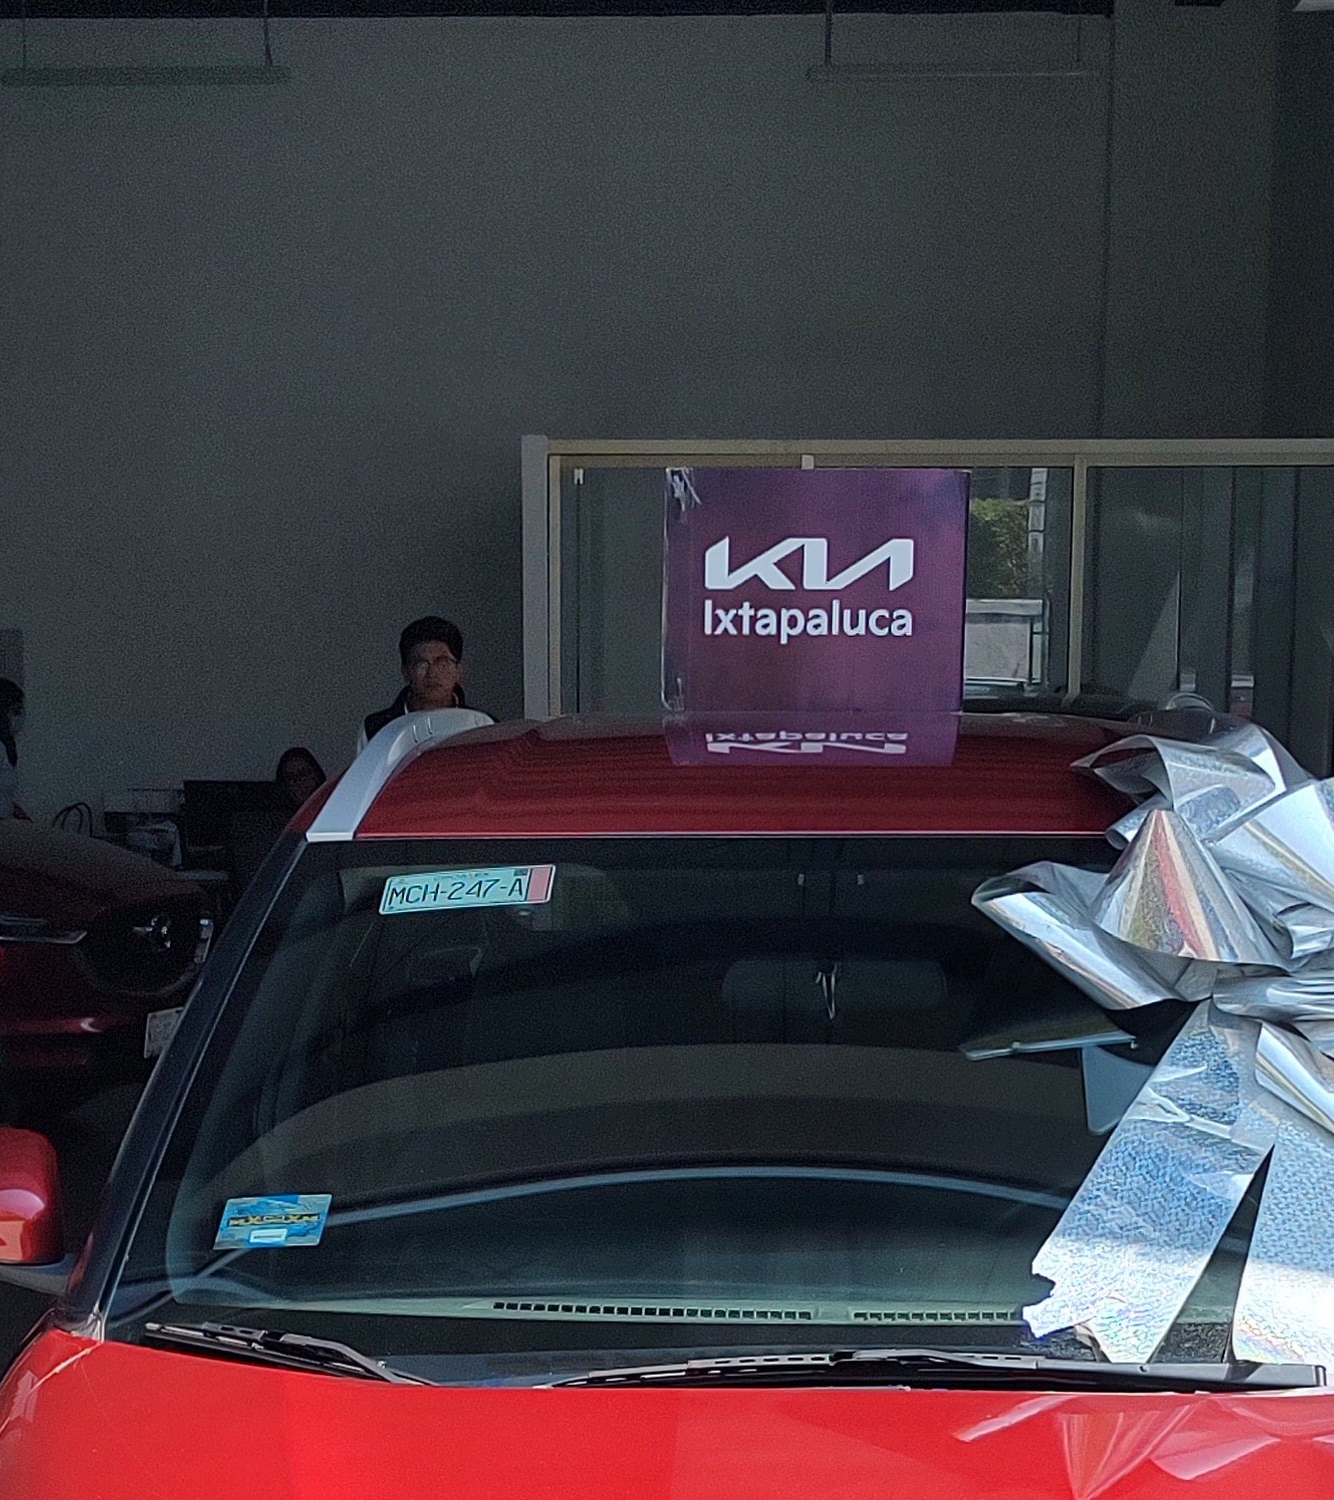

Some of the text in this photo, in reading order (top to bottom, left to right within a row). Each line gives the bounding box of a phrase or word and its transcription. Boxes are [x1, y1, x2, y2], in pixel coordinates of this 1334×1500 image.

[704, 536, 914, 591] KIA
[704, 599, 913, 645] Ixtapaluca
[388, 878, 524, 906] MCH-247-A
